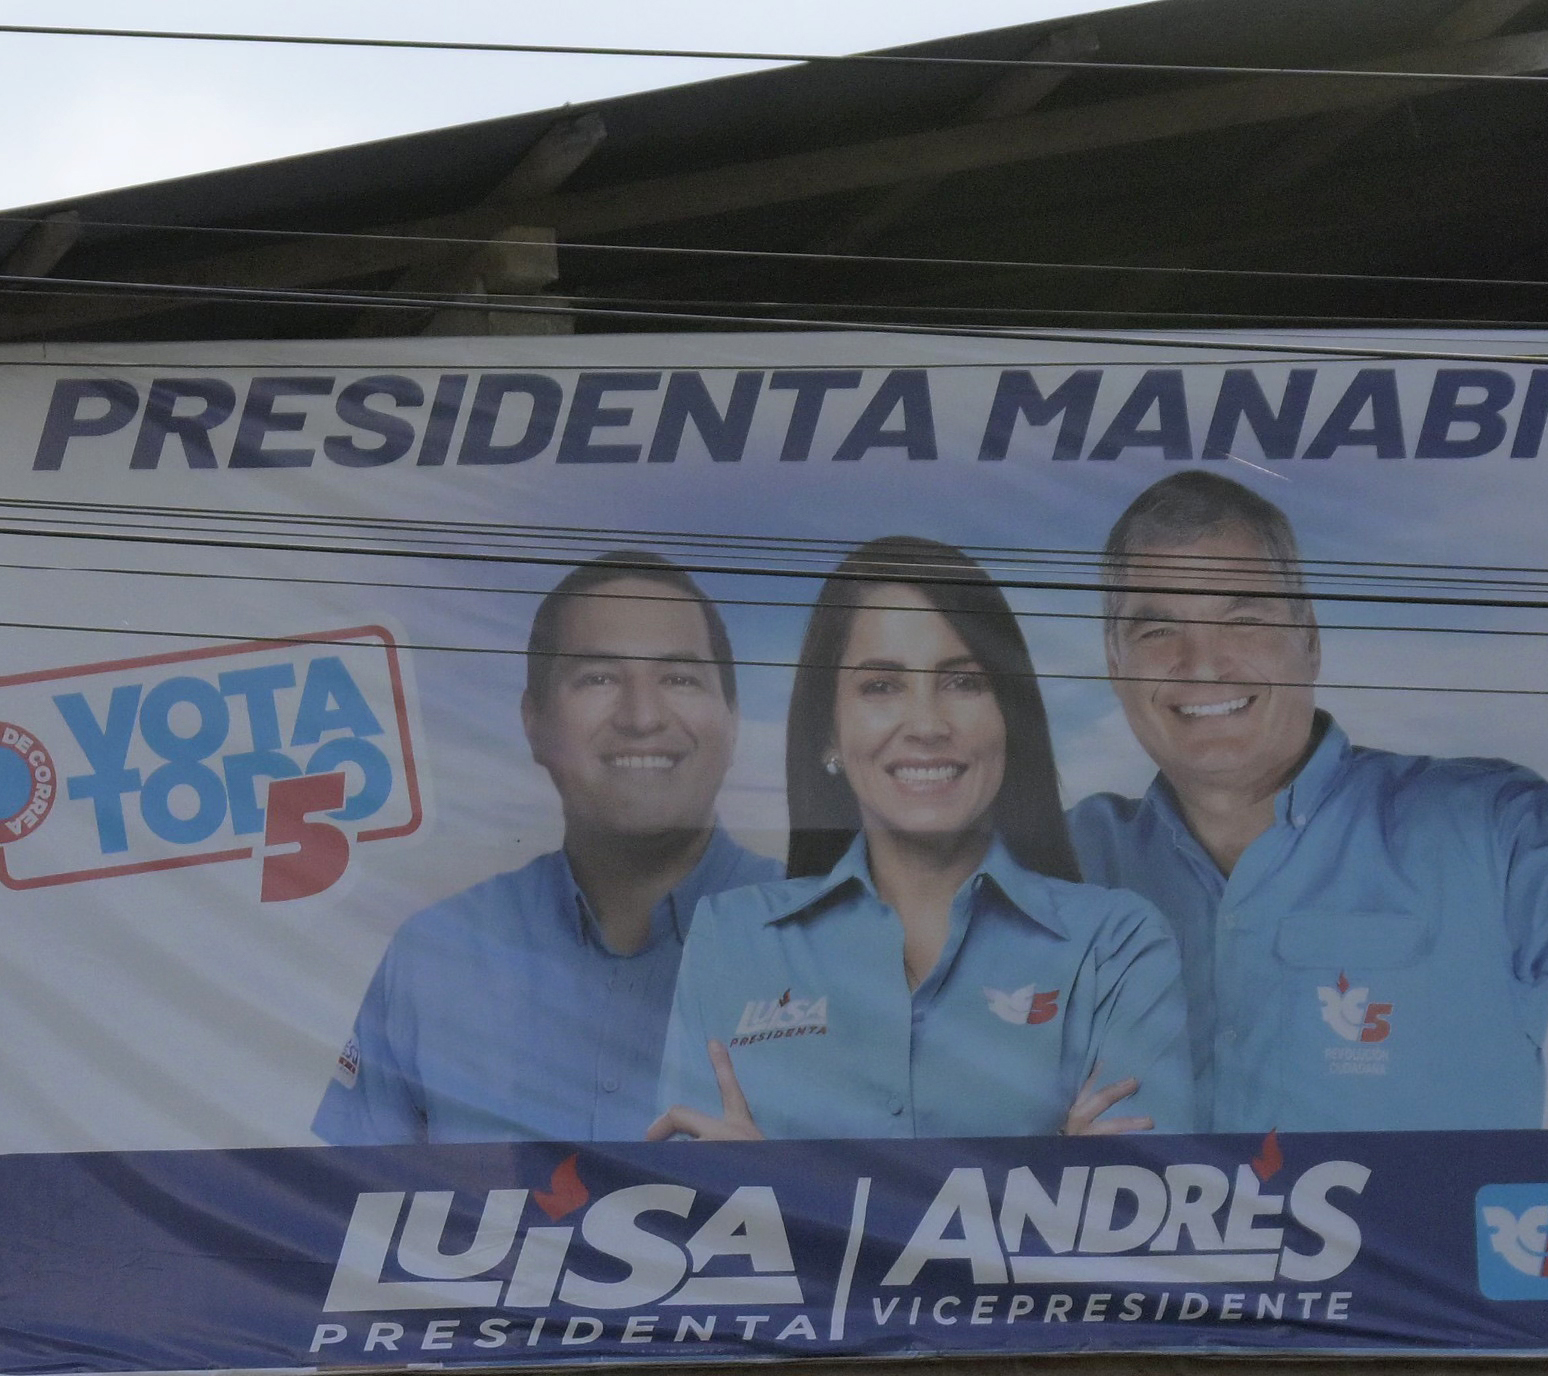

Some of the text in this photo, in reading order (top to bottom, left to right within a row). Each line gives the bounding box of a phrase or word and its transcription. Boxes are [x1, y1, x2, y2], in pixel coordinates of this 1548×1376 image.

[31, 368, 939, 472] PRESIDENTA
[1, 727, 34, 755] DE
[51, 656, 385, 766] VOTA
[5, 748, 53, 838] CORREA
[66, 736, 394, 855] TODO
[260, 771, 351, 903] 5
[729, 1025, 827, 1049] PRESIDENTA
[308, 1290, 1355, 1353] PRESIDENTA VICEPRESIDENTE
